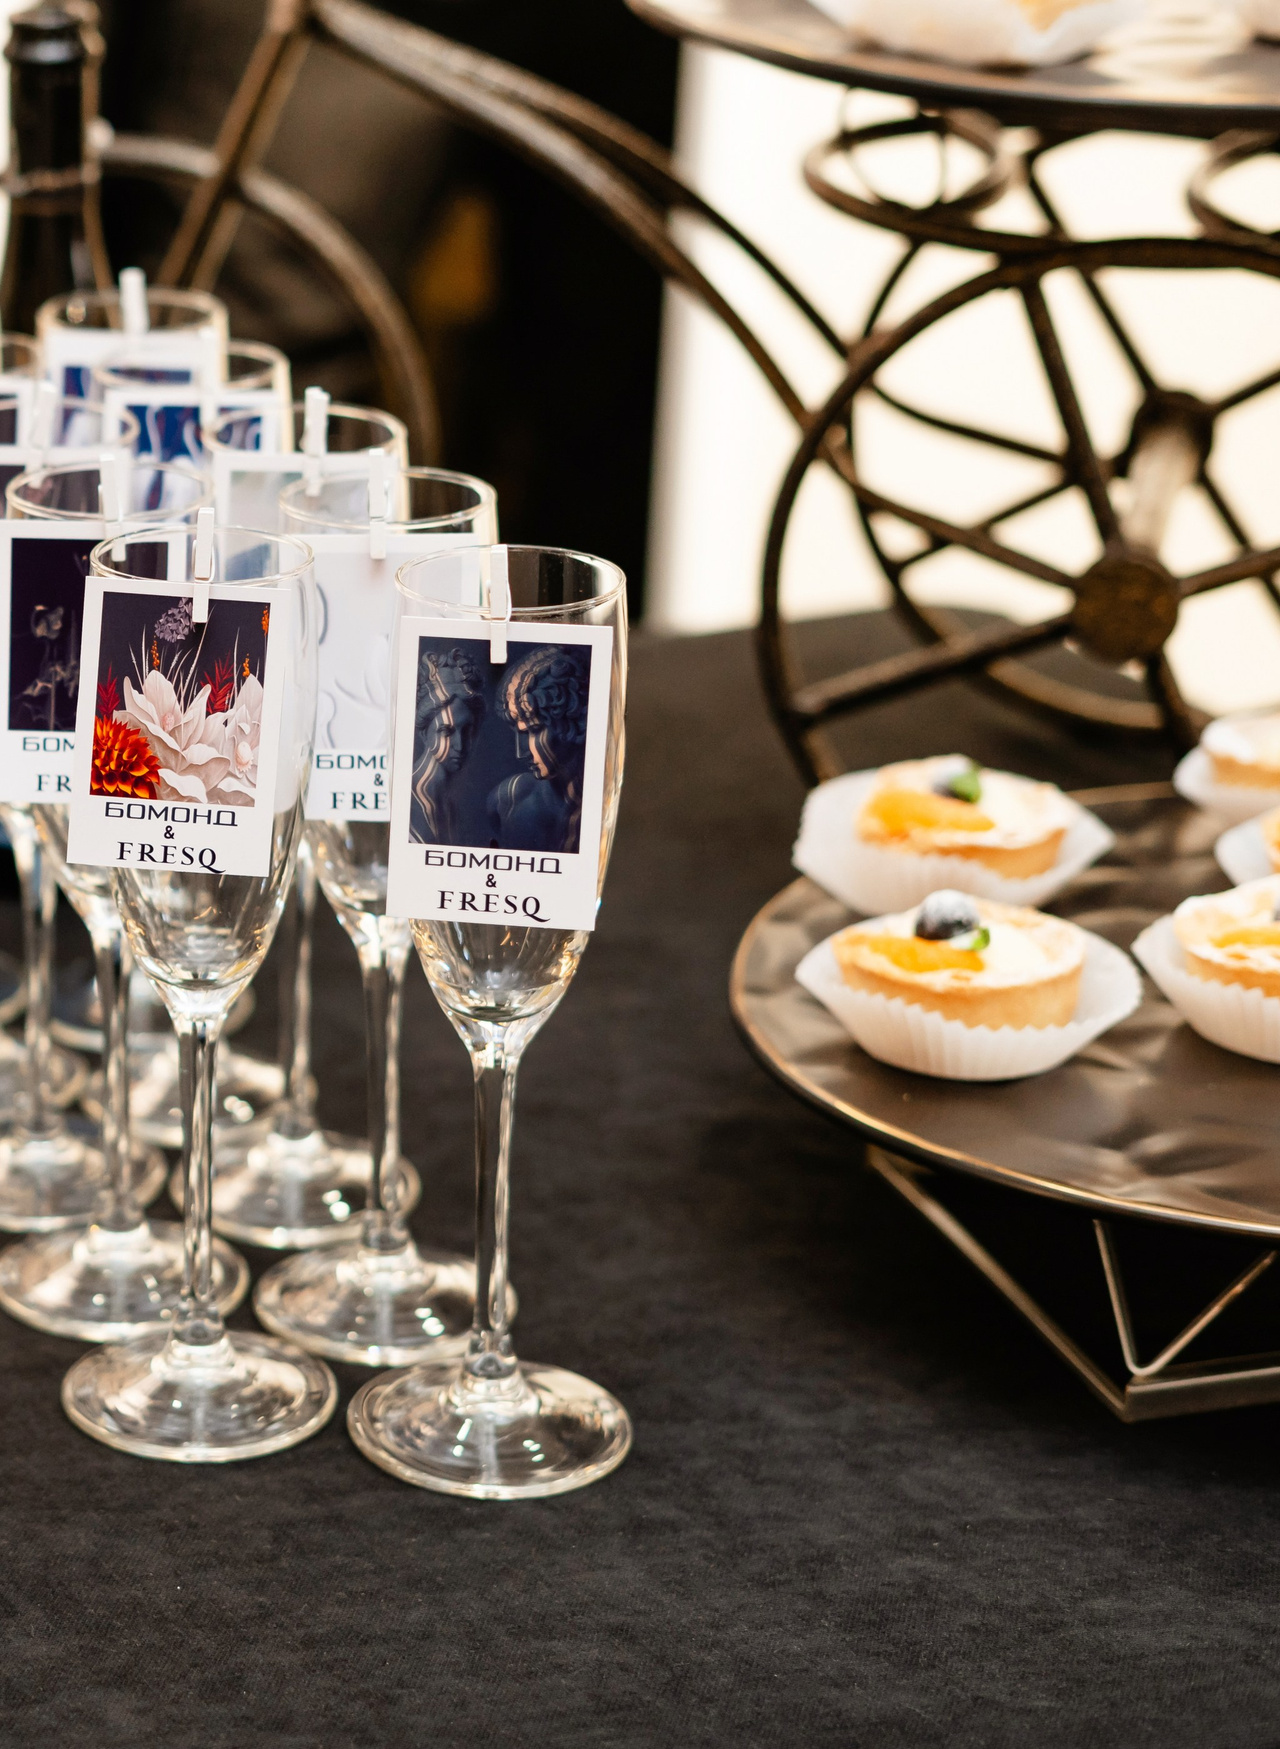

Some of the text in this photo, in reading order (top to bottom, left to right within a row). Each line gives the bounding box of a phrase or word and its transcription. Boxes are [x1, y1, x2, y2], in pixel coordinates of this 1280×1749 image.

[373, 772, 384, 787] &
[330, 791, 388, 811] FRE
[104, 801, 239, 827] БОМОНД
[163, 824, 175, 840] &
[116, 841, 227, 874] FRESQ
[424, 849, 563, 875] БОМОНД
[485, 873, 497, 889] &
[436, 889, 551, 923] FRESQ
